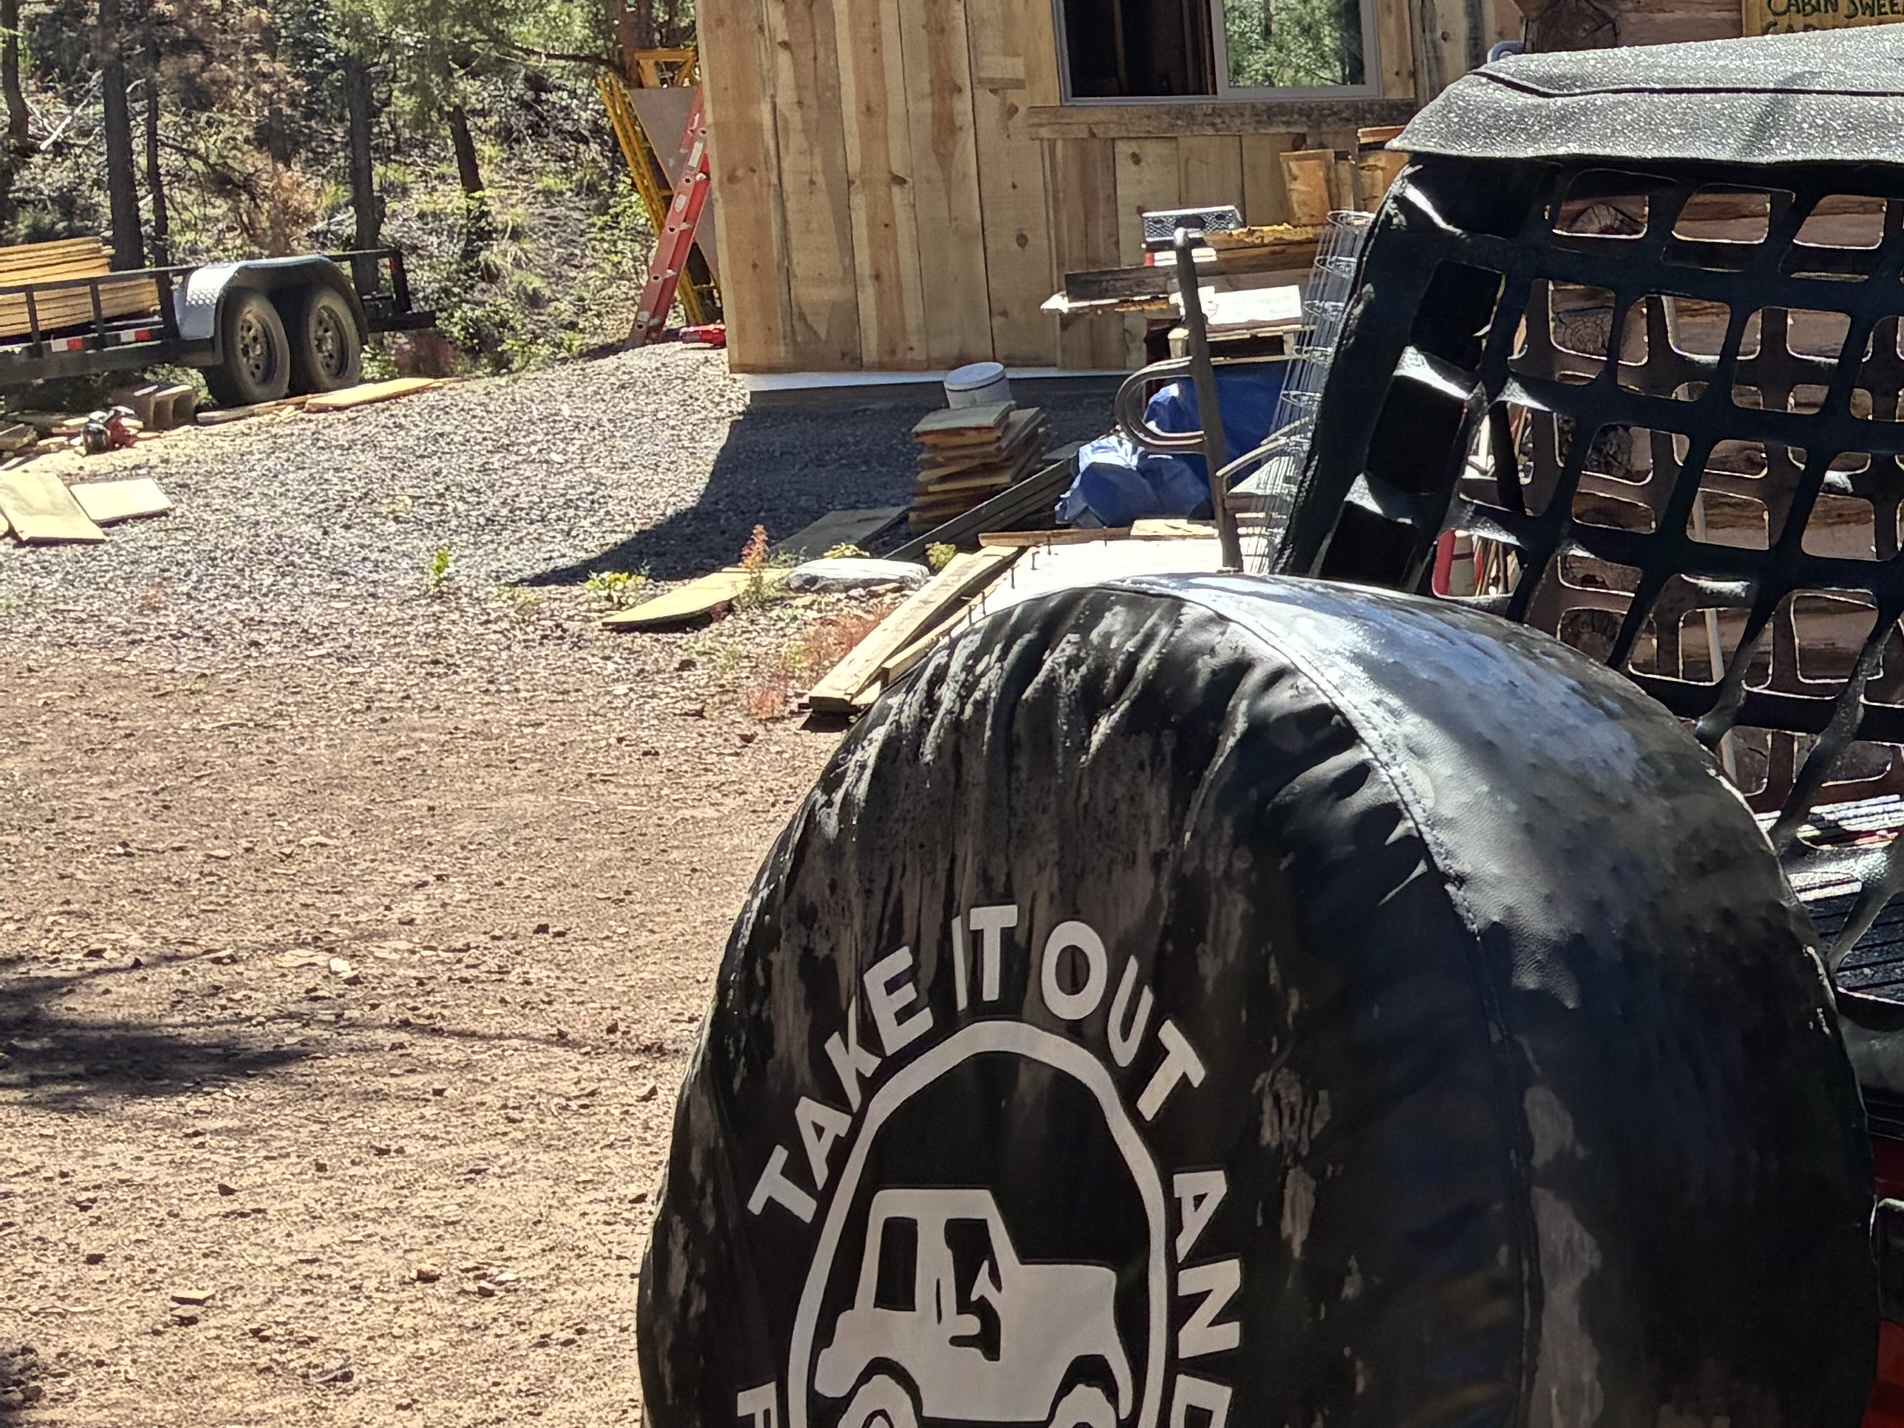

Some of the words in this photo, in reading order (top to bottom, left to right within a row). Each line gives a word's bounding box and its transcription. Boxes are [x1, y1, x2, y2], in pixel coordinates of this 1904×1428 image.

[747, 946, 933, 1224] TAKE
[951, 904, 1018, 1012] IT
[1041, 920, 1206, 1122] OUT
